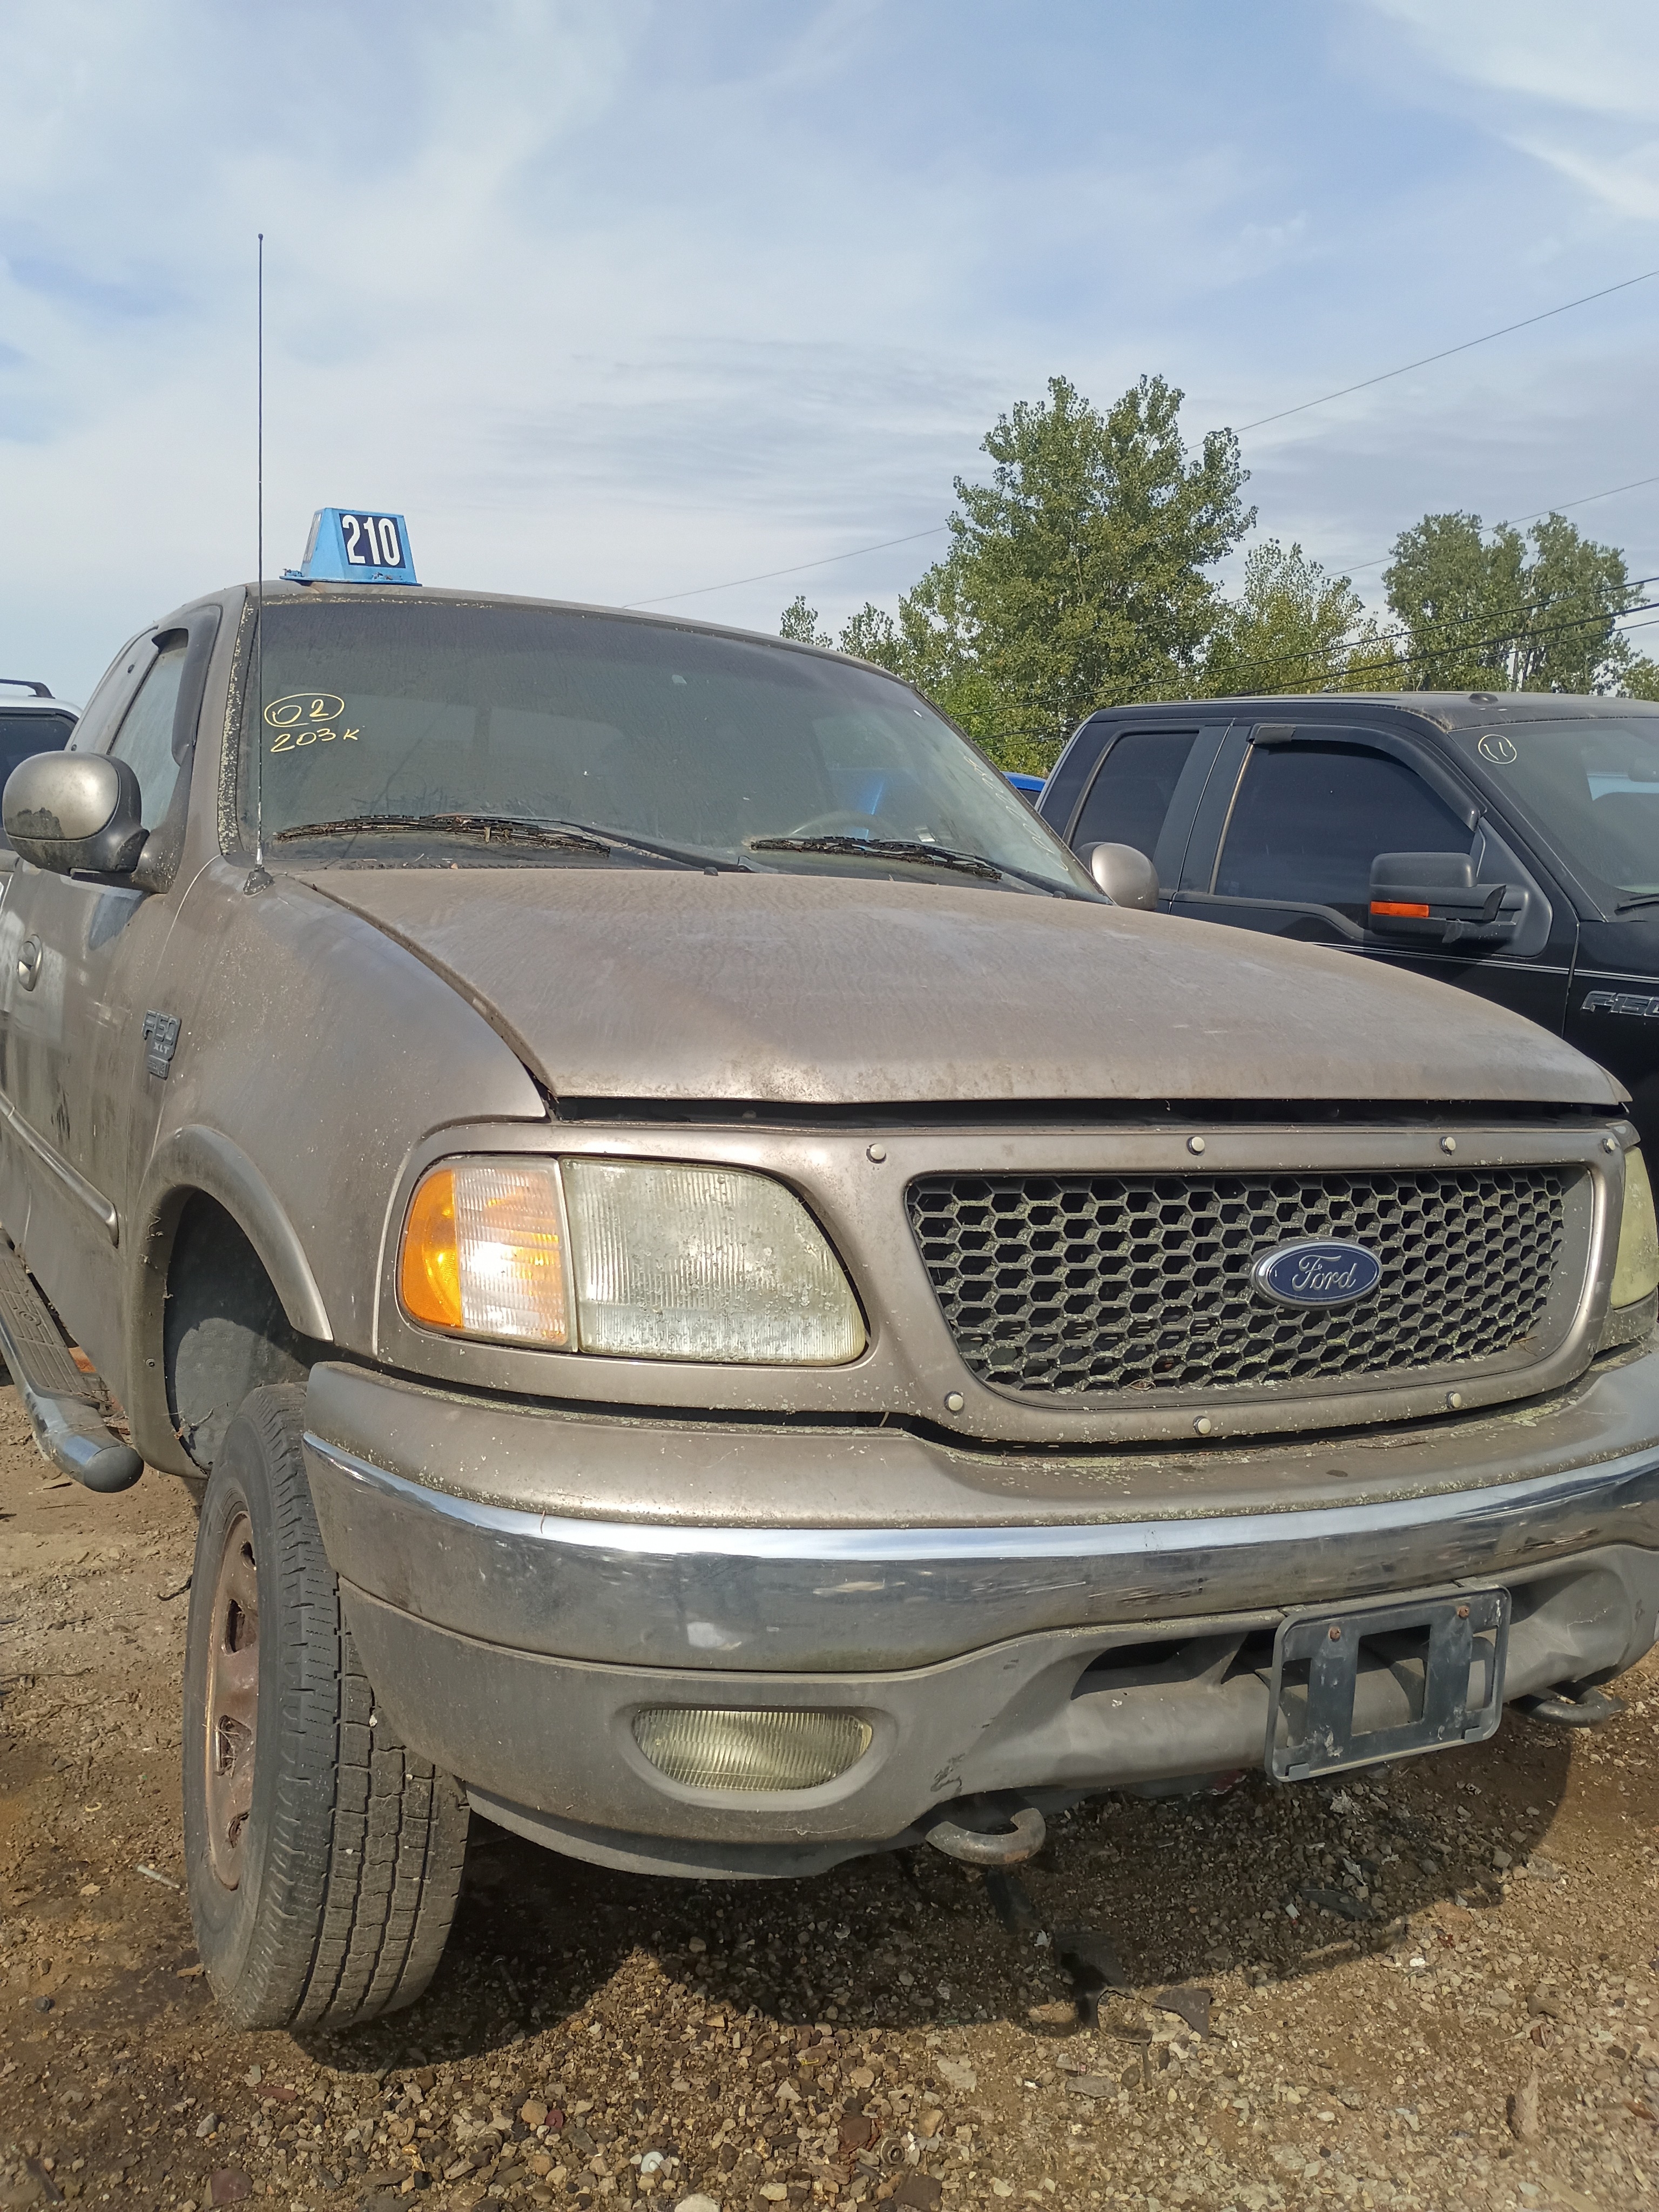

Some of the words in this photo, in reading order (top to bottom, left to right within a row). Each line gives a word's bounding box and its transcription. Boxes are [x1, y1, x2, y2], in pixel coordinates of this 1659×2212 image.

[342, 515, 400, 566] 210
[272, 699, 329, 725] 02
[143, 1009, 178, 1046] F150
[153, 1042, 170, 1054] XLT
[1292, 1255, 1358, 1292] Ford
